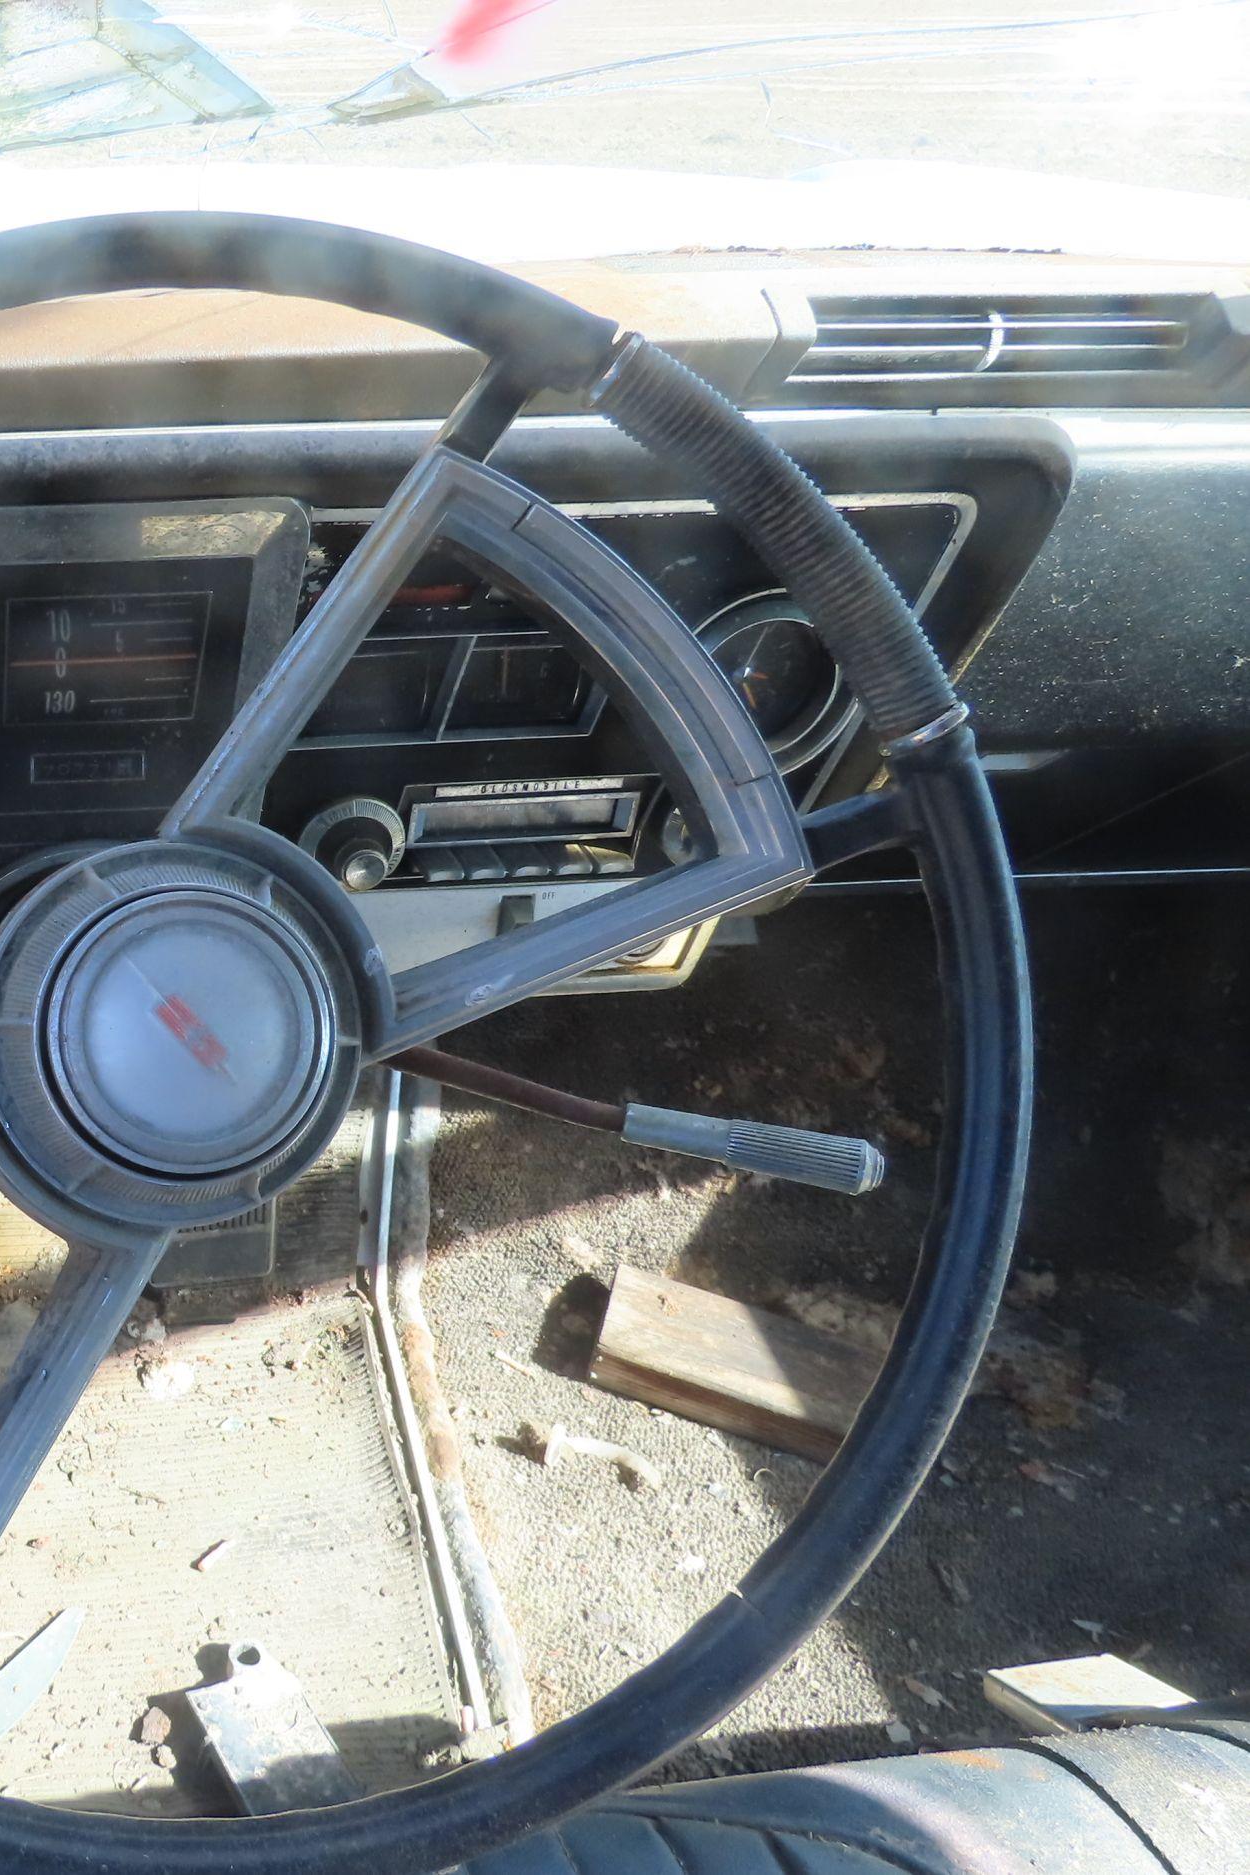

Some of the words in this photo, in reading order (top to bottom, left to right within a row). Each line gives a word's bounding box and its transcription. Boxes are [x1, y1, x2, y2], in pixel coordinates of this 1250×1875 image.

[46, 608, 72, 644] 10
[54, 646, 68, 680] 0
[43, 689, 77, 715] 130
[480, 780, 581, 795] OLDSMOBILE
[541, 891, 556, 901] OFF
